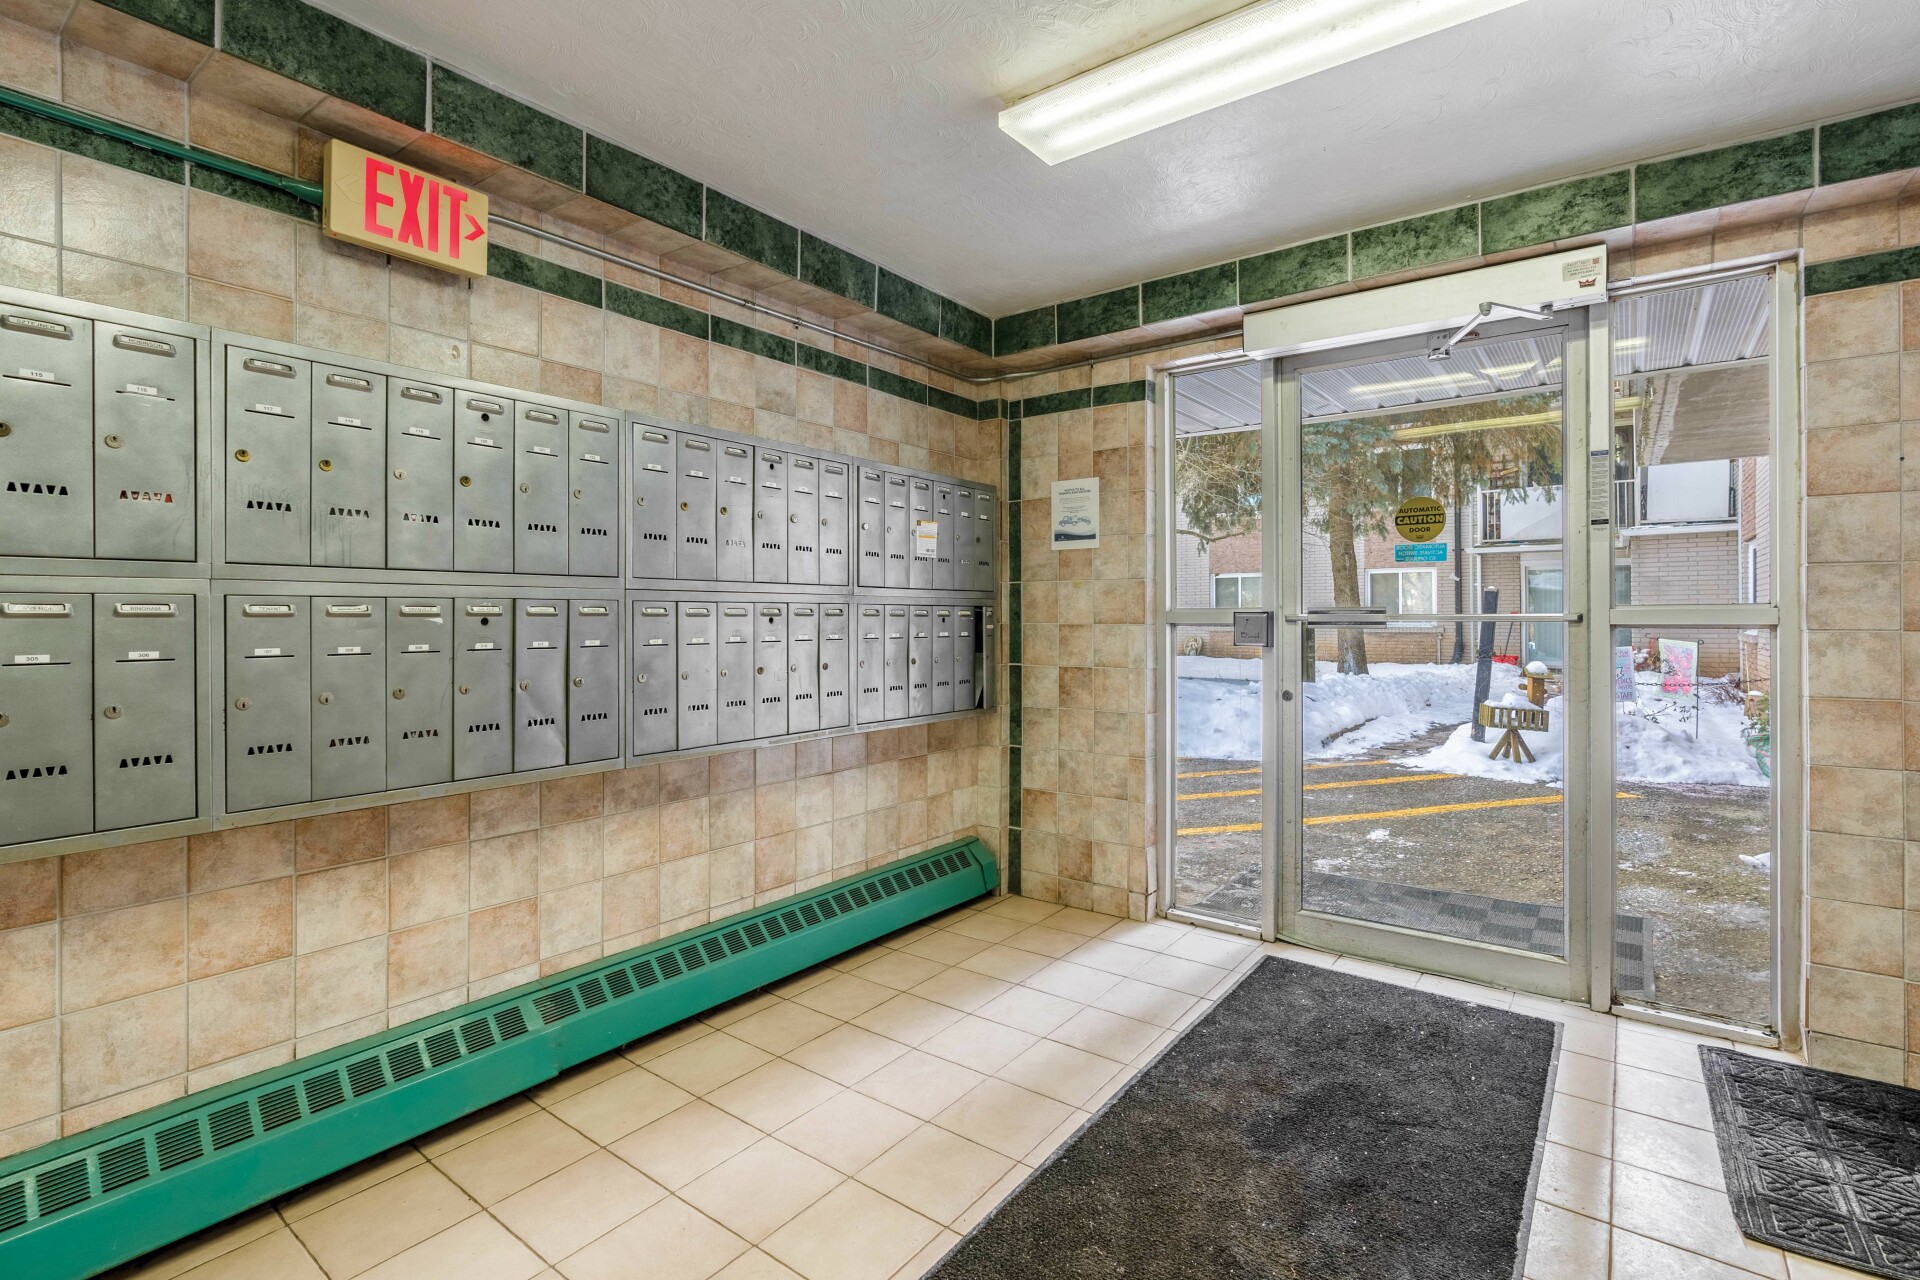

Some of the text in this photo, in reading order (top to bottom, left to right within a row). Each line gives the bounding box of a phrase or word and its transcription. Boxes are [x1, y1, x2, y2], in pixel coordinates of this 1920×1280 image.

[364, 156, 468, 260] EXIT
[1399, 506, 1441, 514] AUTOMATIC
[1396, 515, 1443, 525] CAUTION
